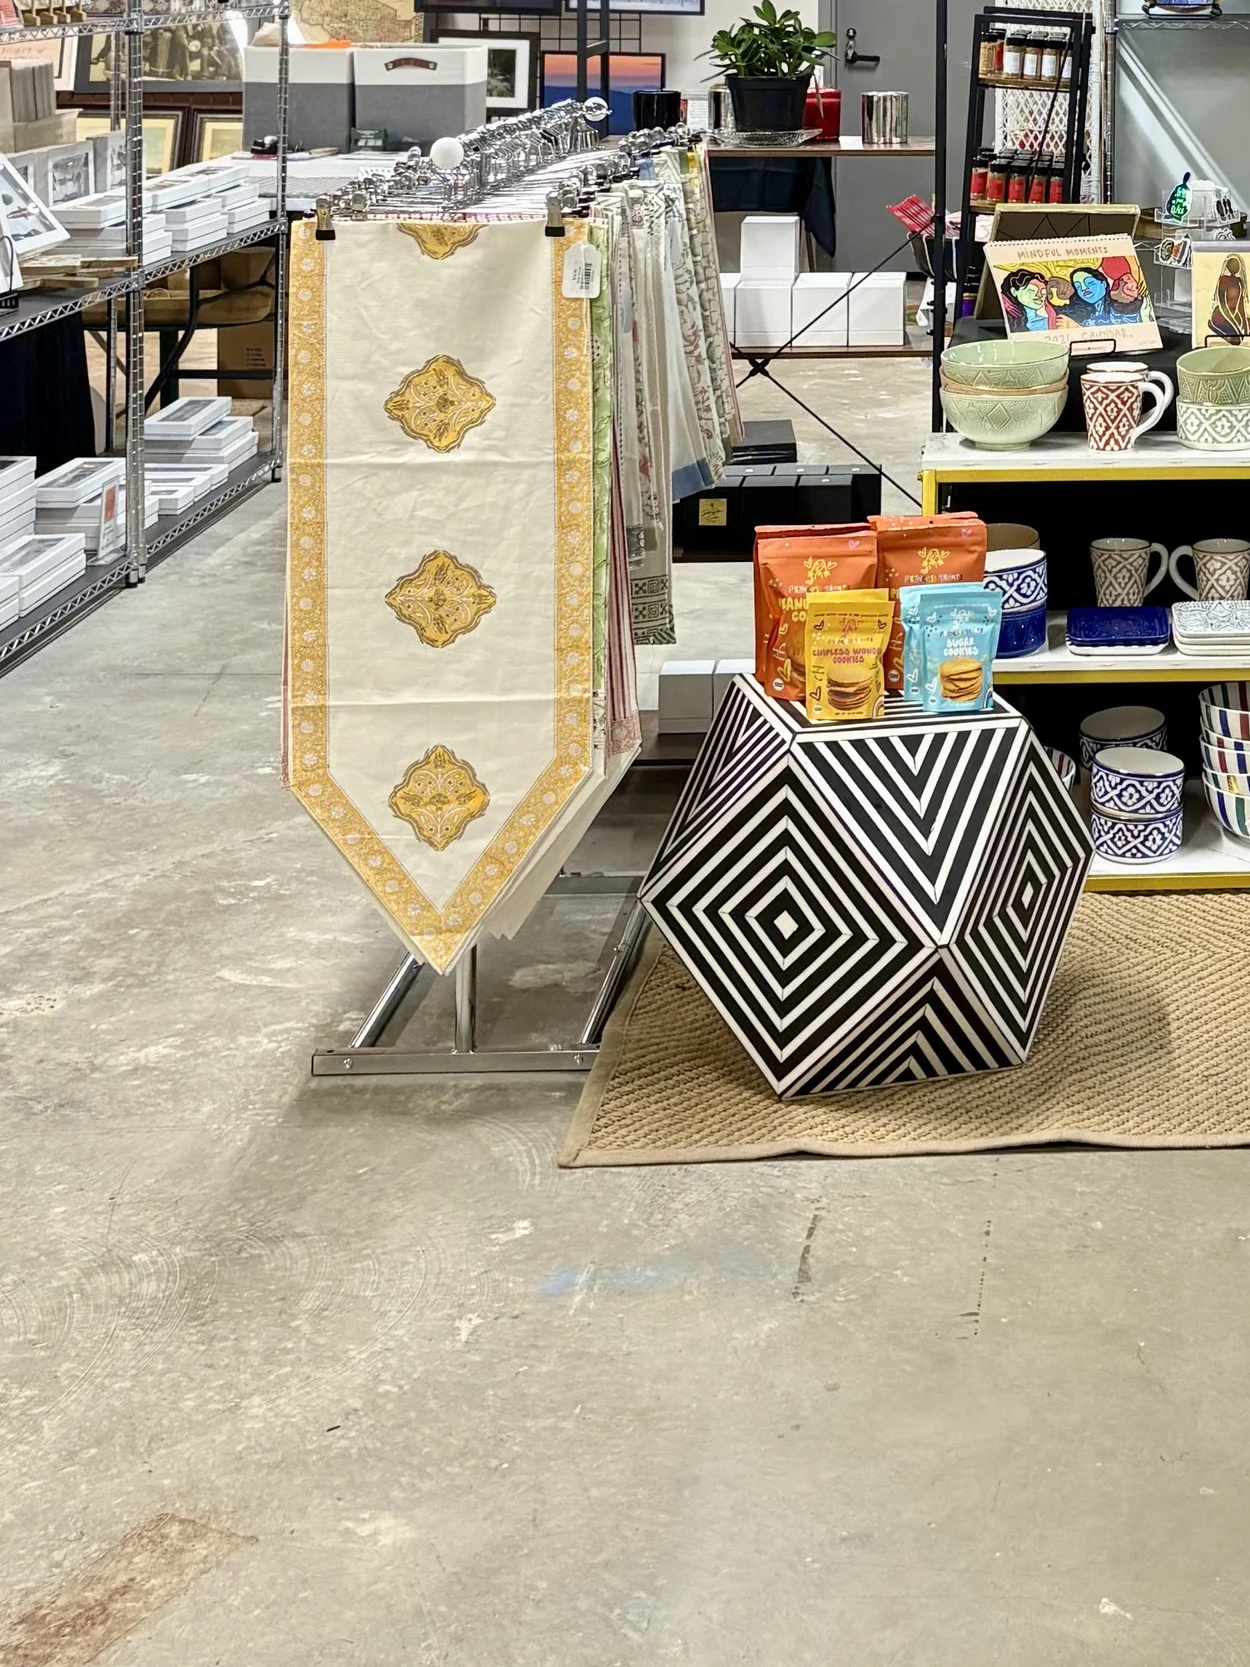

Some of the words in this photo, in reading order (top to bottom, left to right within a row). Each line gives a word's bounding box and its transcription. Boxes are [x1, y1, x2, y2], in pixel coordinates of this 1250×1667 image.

[1065, 245, 1108, 257] MOMENTS
[946, 637, 975, 648] SUGAR
[943, 646, 979, 657] COOKIES
